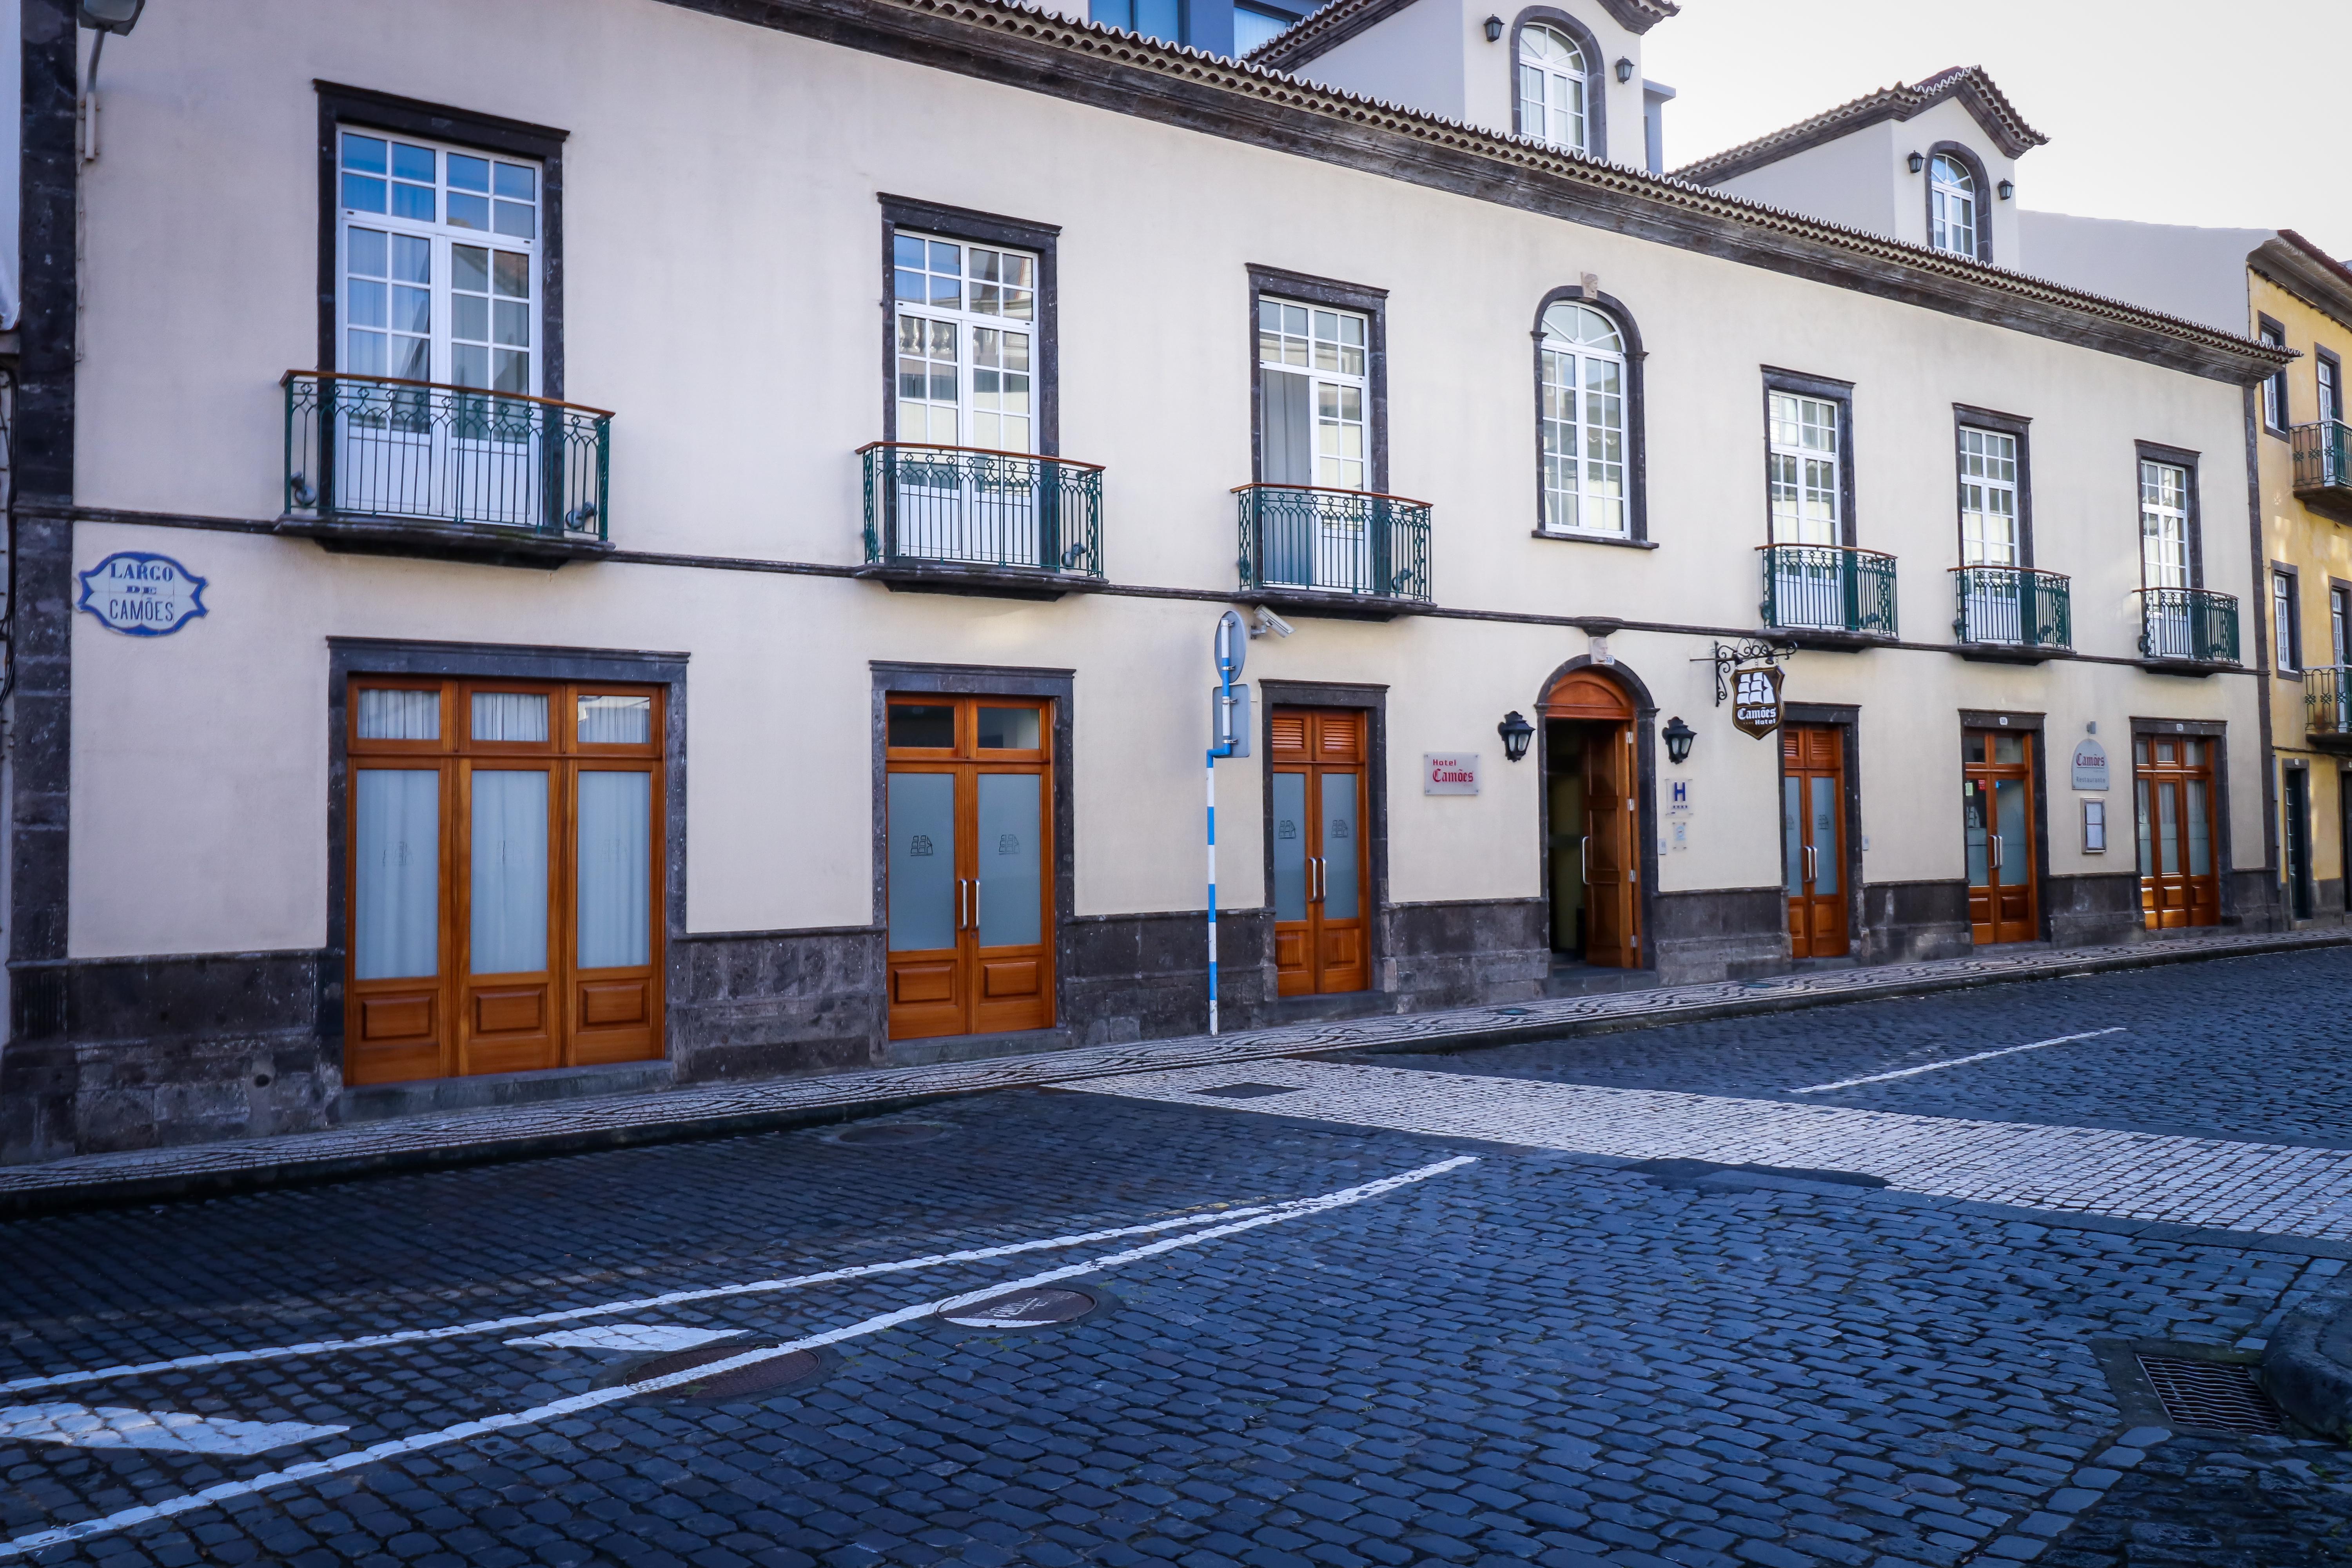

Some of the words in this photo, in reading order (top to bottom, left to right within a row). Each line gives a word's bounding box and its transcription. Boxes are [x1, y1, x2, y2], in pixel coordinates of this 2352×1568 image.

[111, 563, 173, 582] LARGO
[126, 586, 156, 594] DE
[110, 597, 173, 621] CAMÕES
[1737, 707, 1777, 719] Camões
[2076, 753, 2105, 766] Camões
[1433, 769, 1473, 782] Camões
[1675, 782, 1685, 801] H
